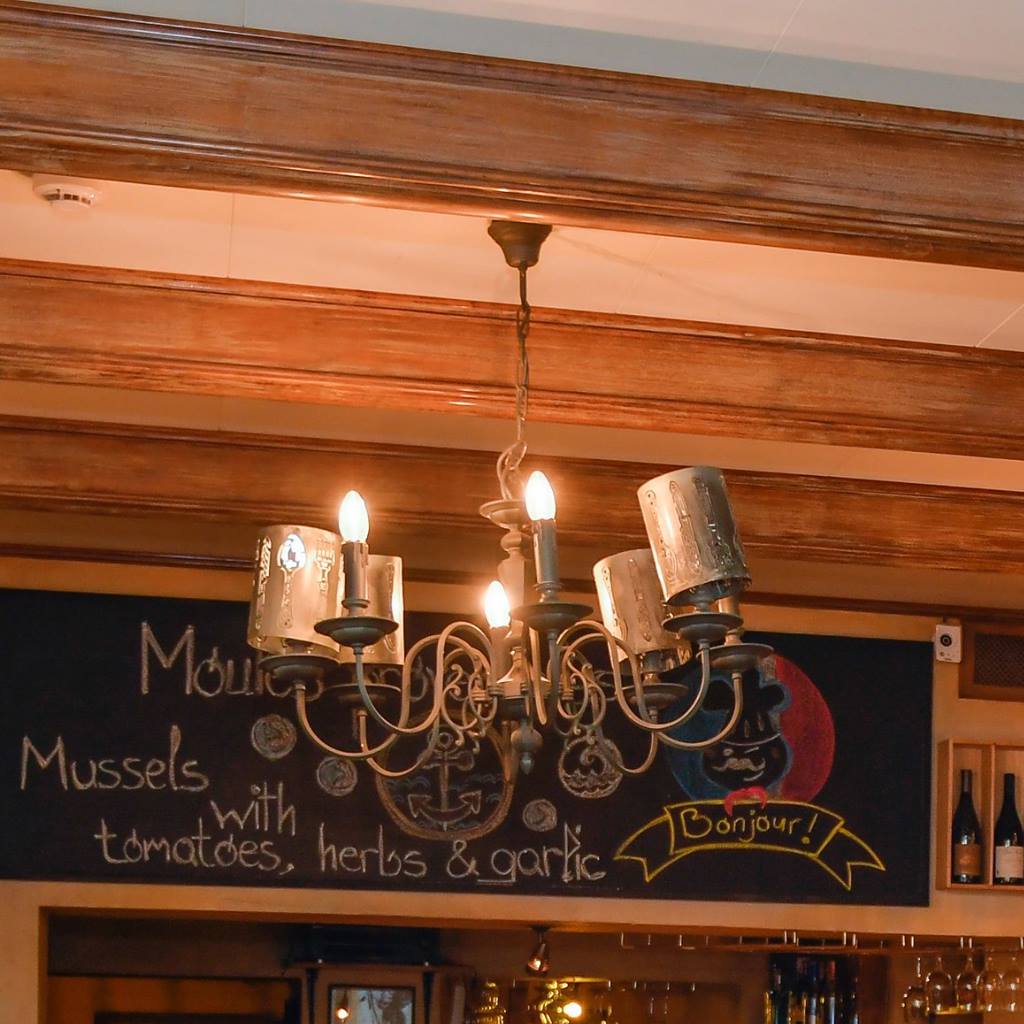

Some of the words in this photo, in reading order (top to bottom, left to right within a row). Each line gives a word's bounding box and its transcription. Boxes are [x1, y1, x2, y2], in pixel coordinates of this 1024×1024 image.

[19, 724, 211, 793] Mussels
[210, 782, 298, 836] with
[94, 817, 295, 875] tomatoes,
[318, 821, 428, 878] herbs
[446, 840, 480, 878] &
[484, 821, 607, 886] garlic
